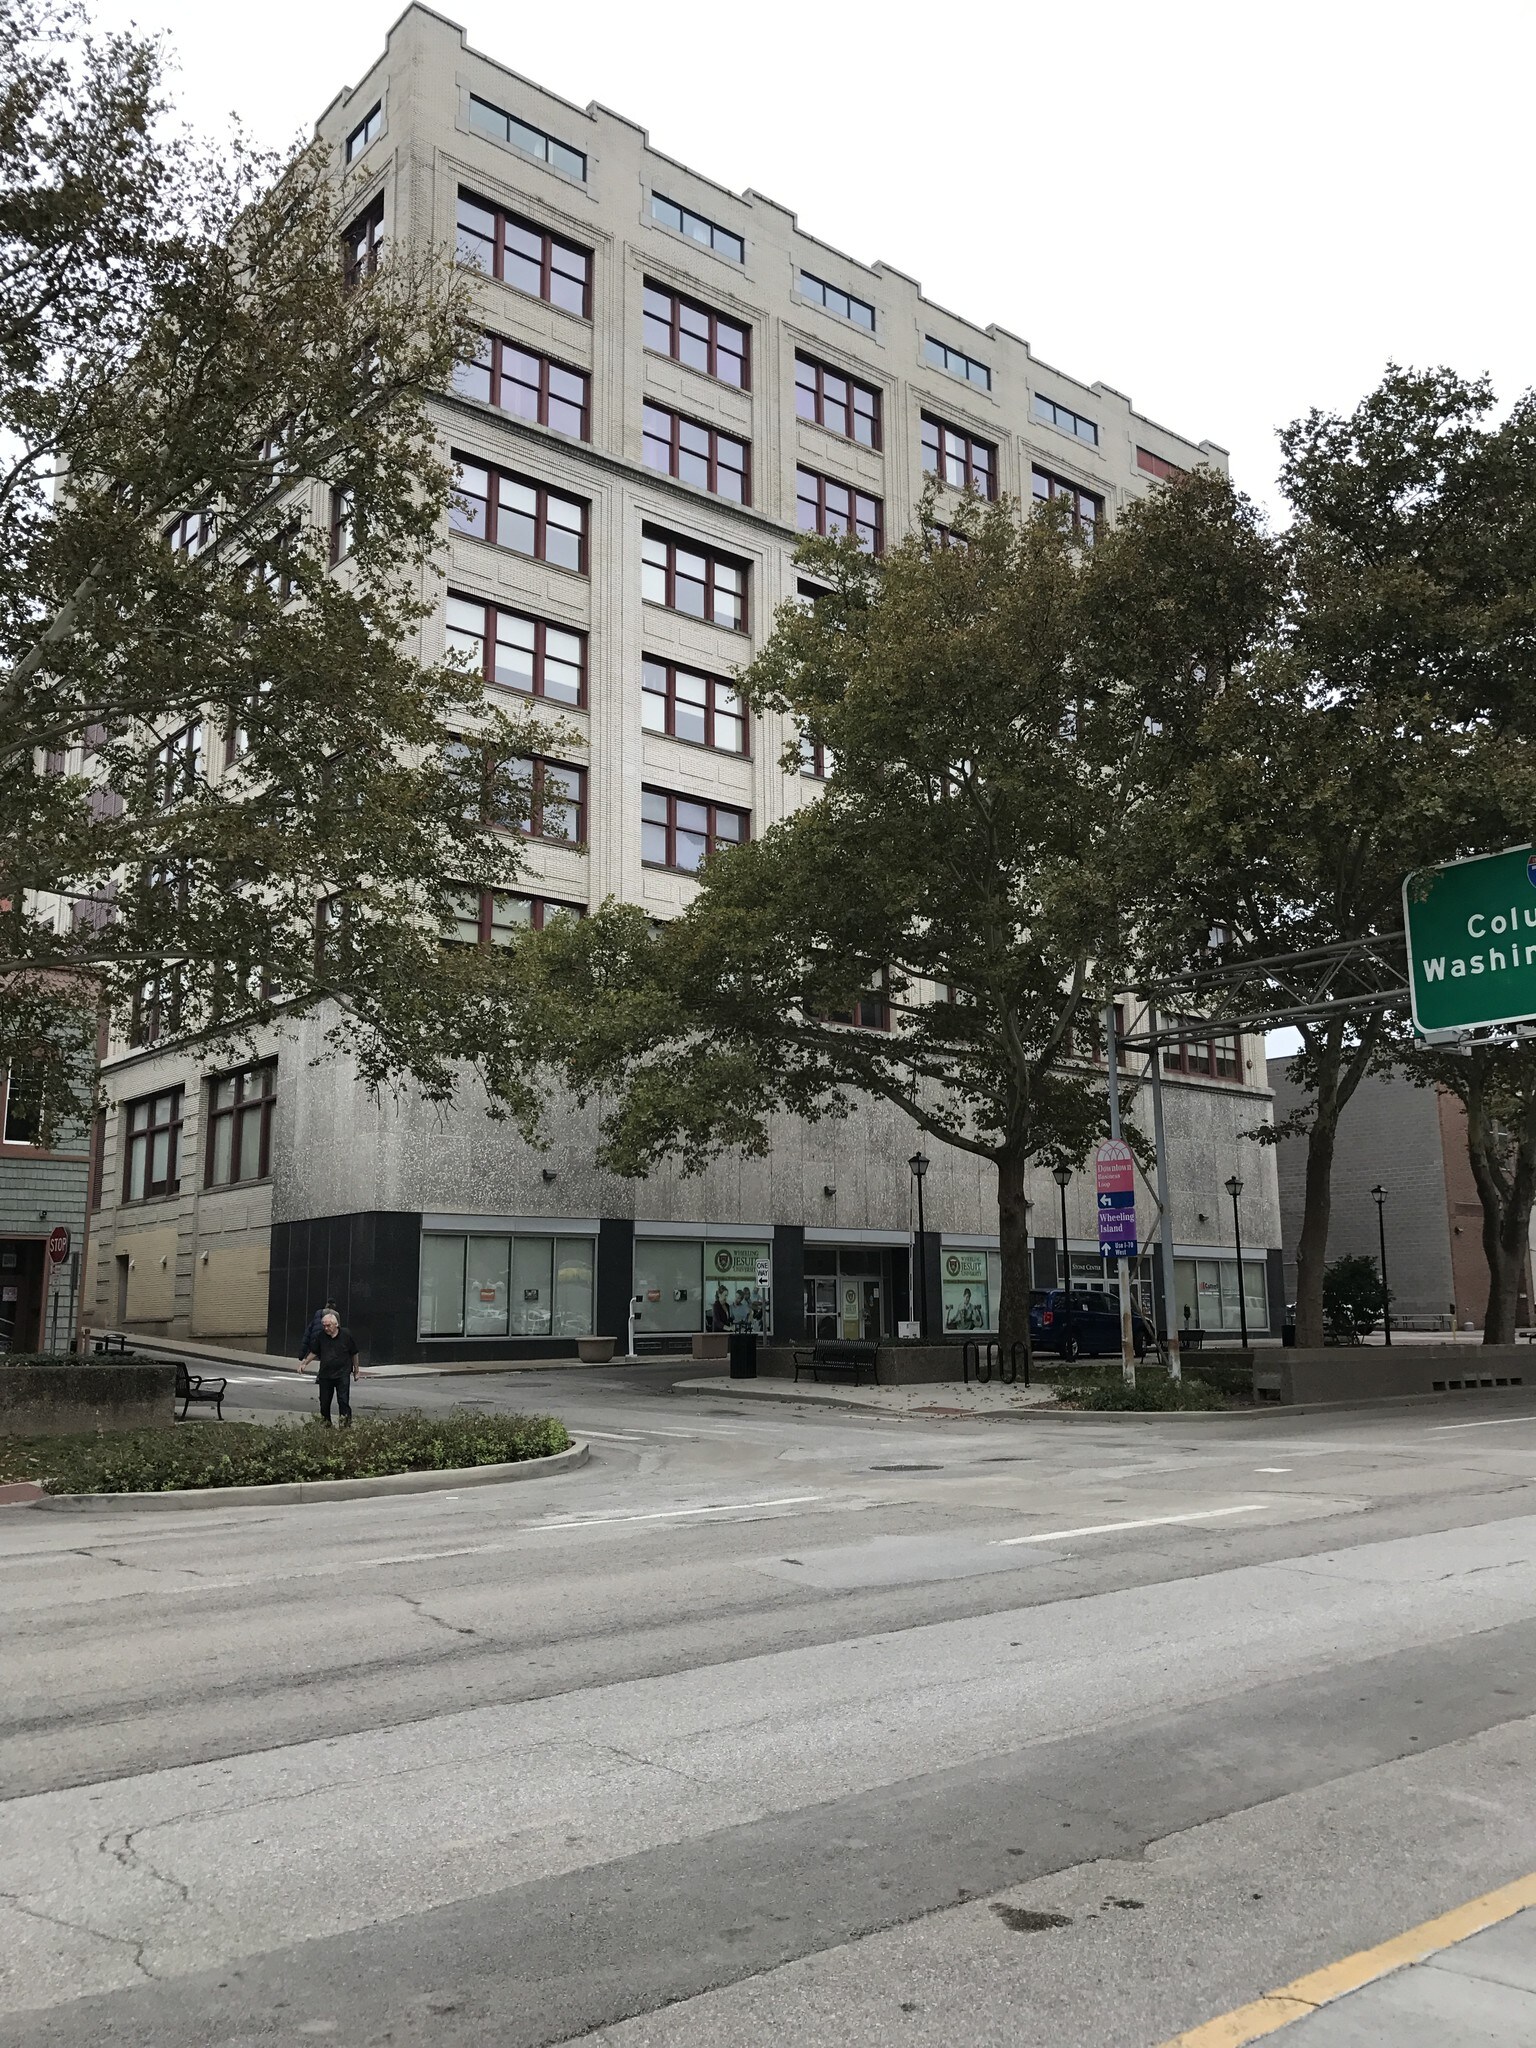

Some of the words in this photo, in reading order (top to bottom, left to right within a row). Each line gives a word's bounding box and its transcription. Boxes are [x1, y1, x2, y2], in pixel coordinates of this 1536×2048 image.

[1467, 906, 1536, 938] Colu
[1097, 1164, 1132, 1172] Downtown
[1099, 1212, 1135, 1223] Wheeling
[1100, 1223, 1123, 1233] Island
[50, 1238, 67, 1252] STOP
[1123, 1241, 1134, 1249] I-70
[961, 1262, 982, 1271] JESUIT
[1085, 1263, 1102, 1271] CENTER
